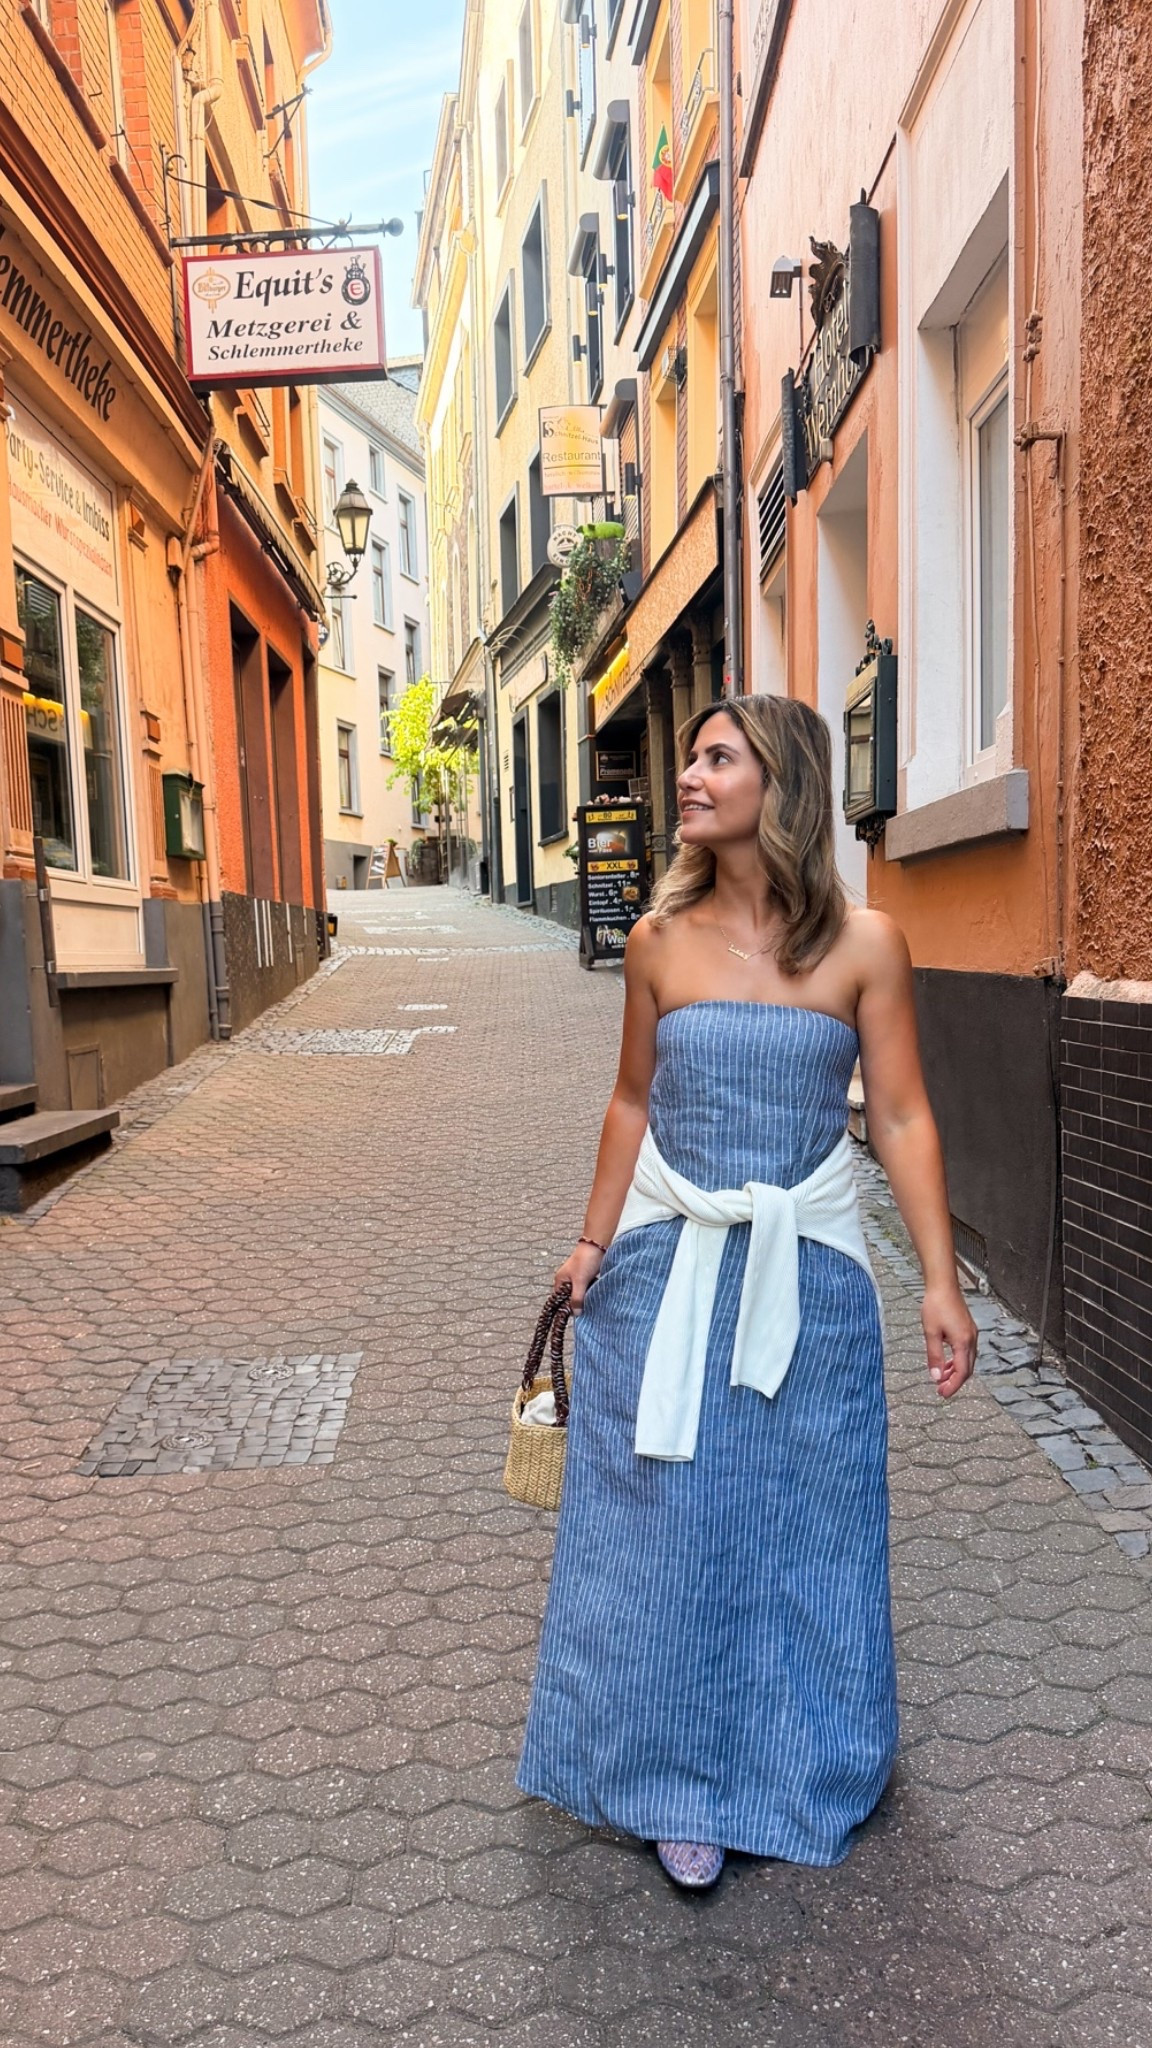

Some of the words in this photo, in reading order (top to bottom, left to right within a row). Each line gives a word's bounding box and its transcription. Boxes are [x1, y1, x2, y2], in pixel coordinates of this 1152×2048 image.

[232, 268, 333, 306] Equit's
[0, 224, 116, 422] emmertheke
[206, 315, 332, 340] Metzgerei
[340, 310, 363, 331] &
[812, 279, 850, 395] Hotel
[208, 337, 363, 361] Schlemmertheke
[543, 451, 601, 463] Restaurant
[82, 490, 110, 542] Imbiss
[587, 837, 613, 849] Bier
[606, 861, 624, 870] XXL
